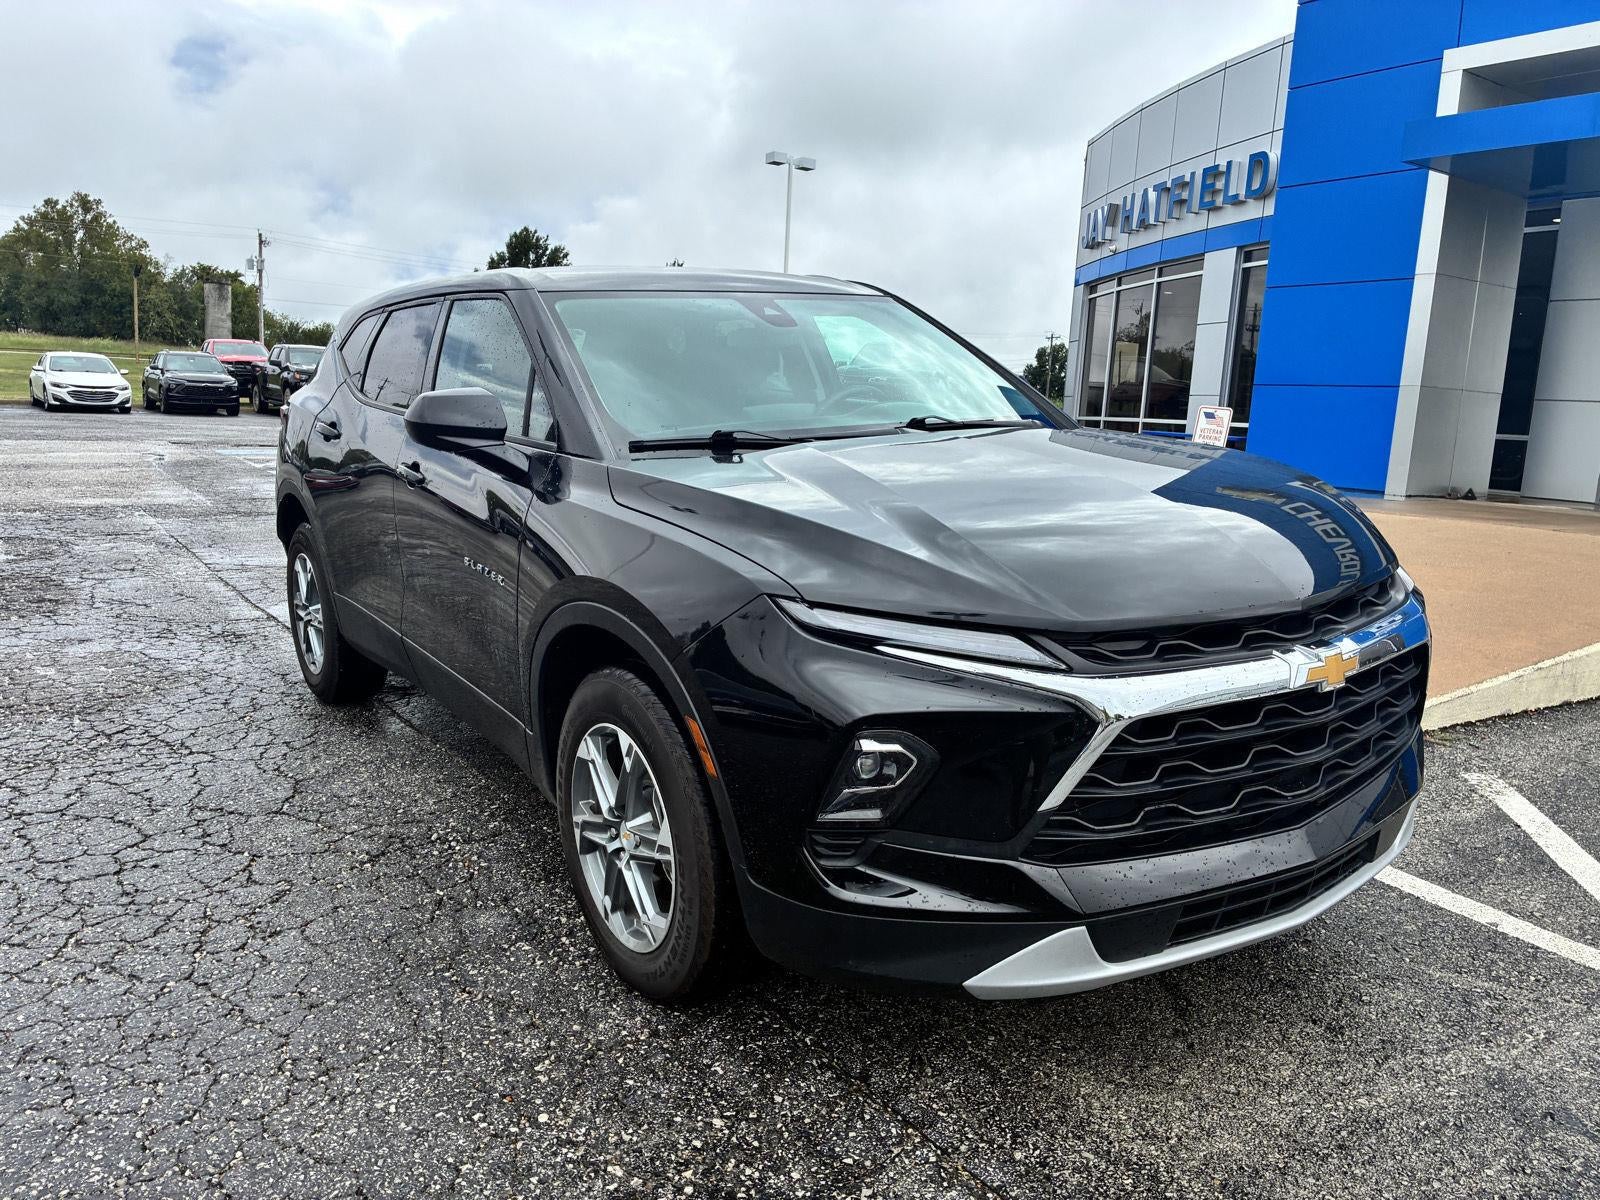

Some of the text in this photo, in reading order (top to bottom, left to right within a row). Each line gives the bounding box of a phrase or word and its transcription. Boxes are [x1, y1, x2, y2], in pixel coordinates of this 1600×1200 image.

[1082, 151, 1278, 249] JAY HATFIELD
[1199, 434, 1221, 442] PARKING
[463, 556, 505, 586] BLAZER
